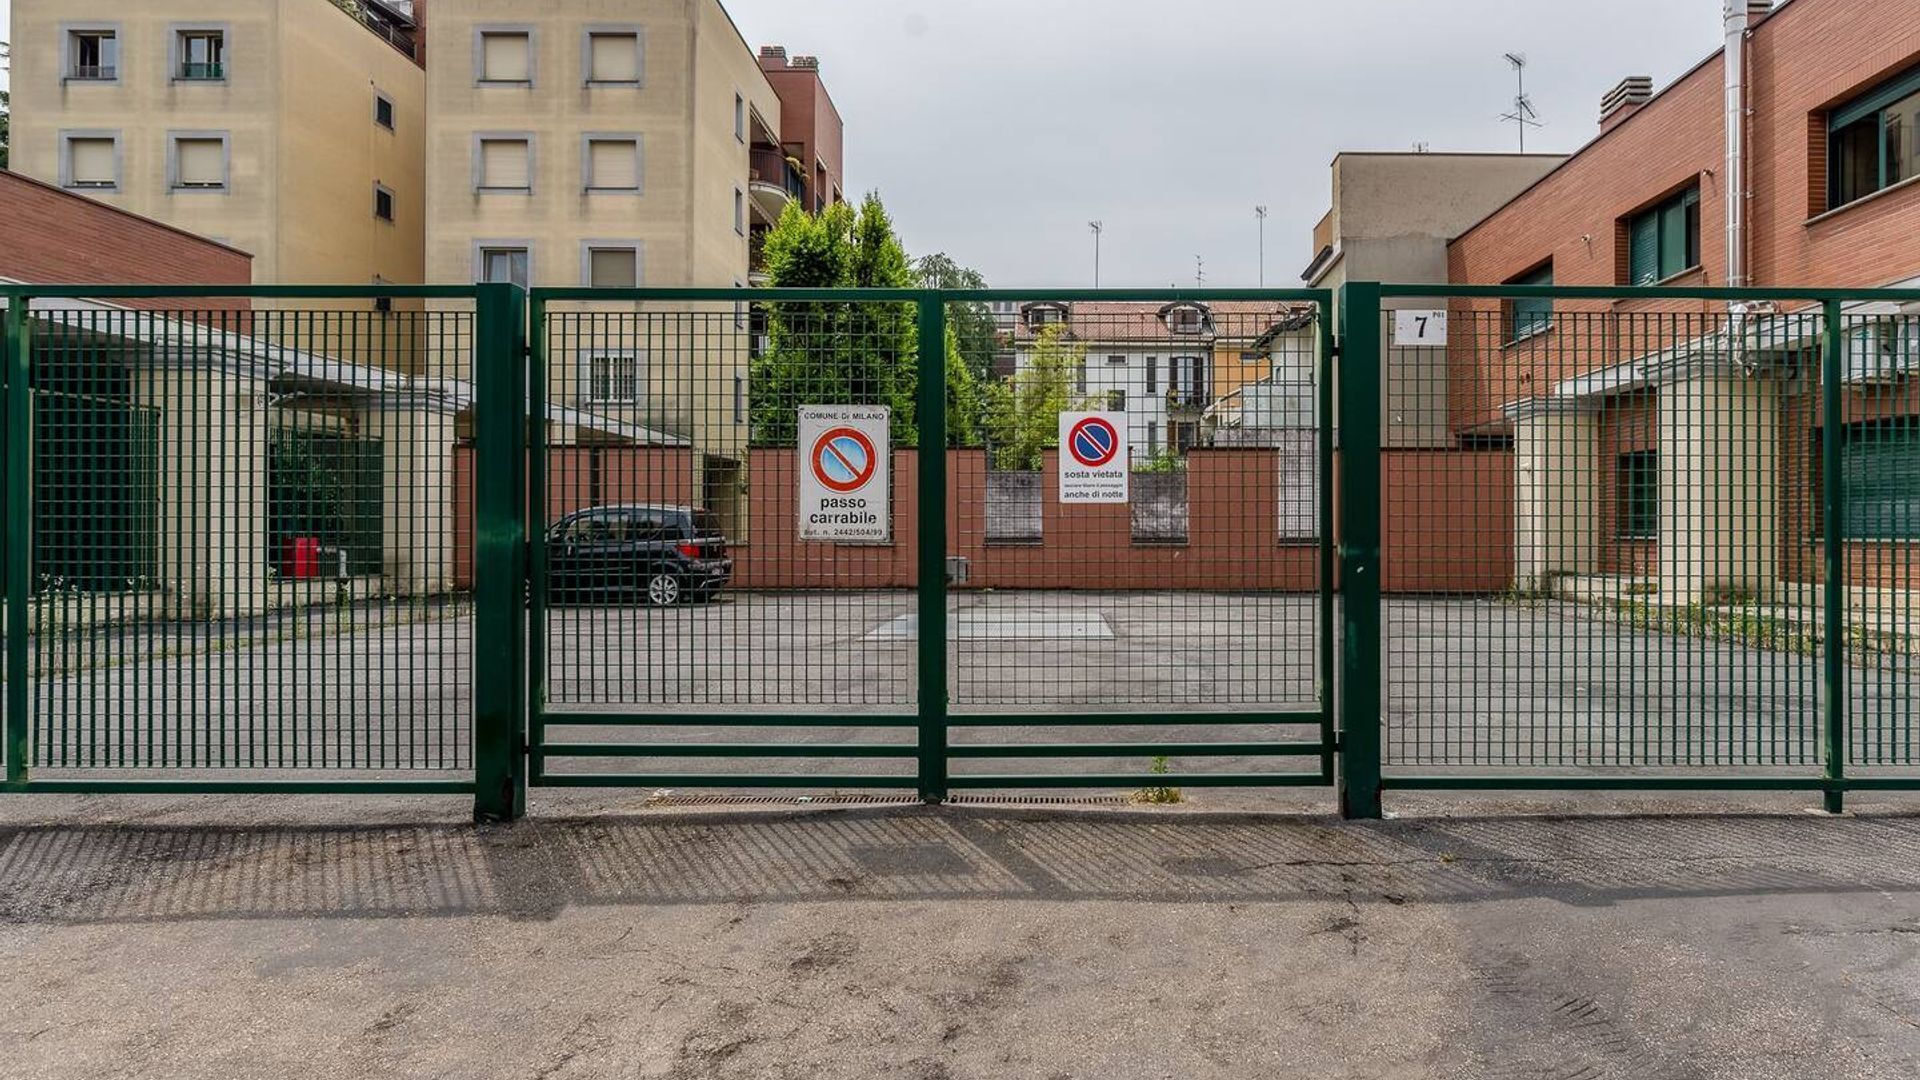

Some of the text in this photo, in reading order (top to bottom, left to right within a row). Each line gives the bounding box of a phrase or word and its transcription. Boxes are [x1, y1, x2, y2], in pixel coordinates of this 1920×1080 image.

[1414, 316, 1428, 338] 7
[804, 412, 838, 420] COMUNE
[852, 412, 884, 420] MILANO
[1092, 470, 1123, 478] vietata
[1091, 490, 1100, 498] di
[821, 498, 866, 511] passo
[810, 511, 877, 524] carrabile
